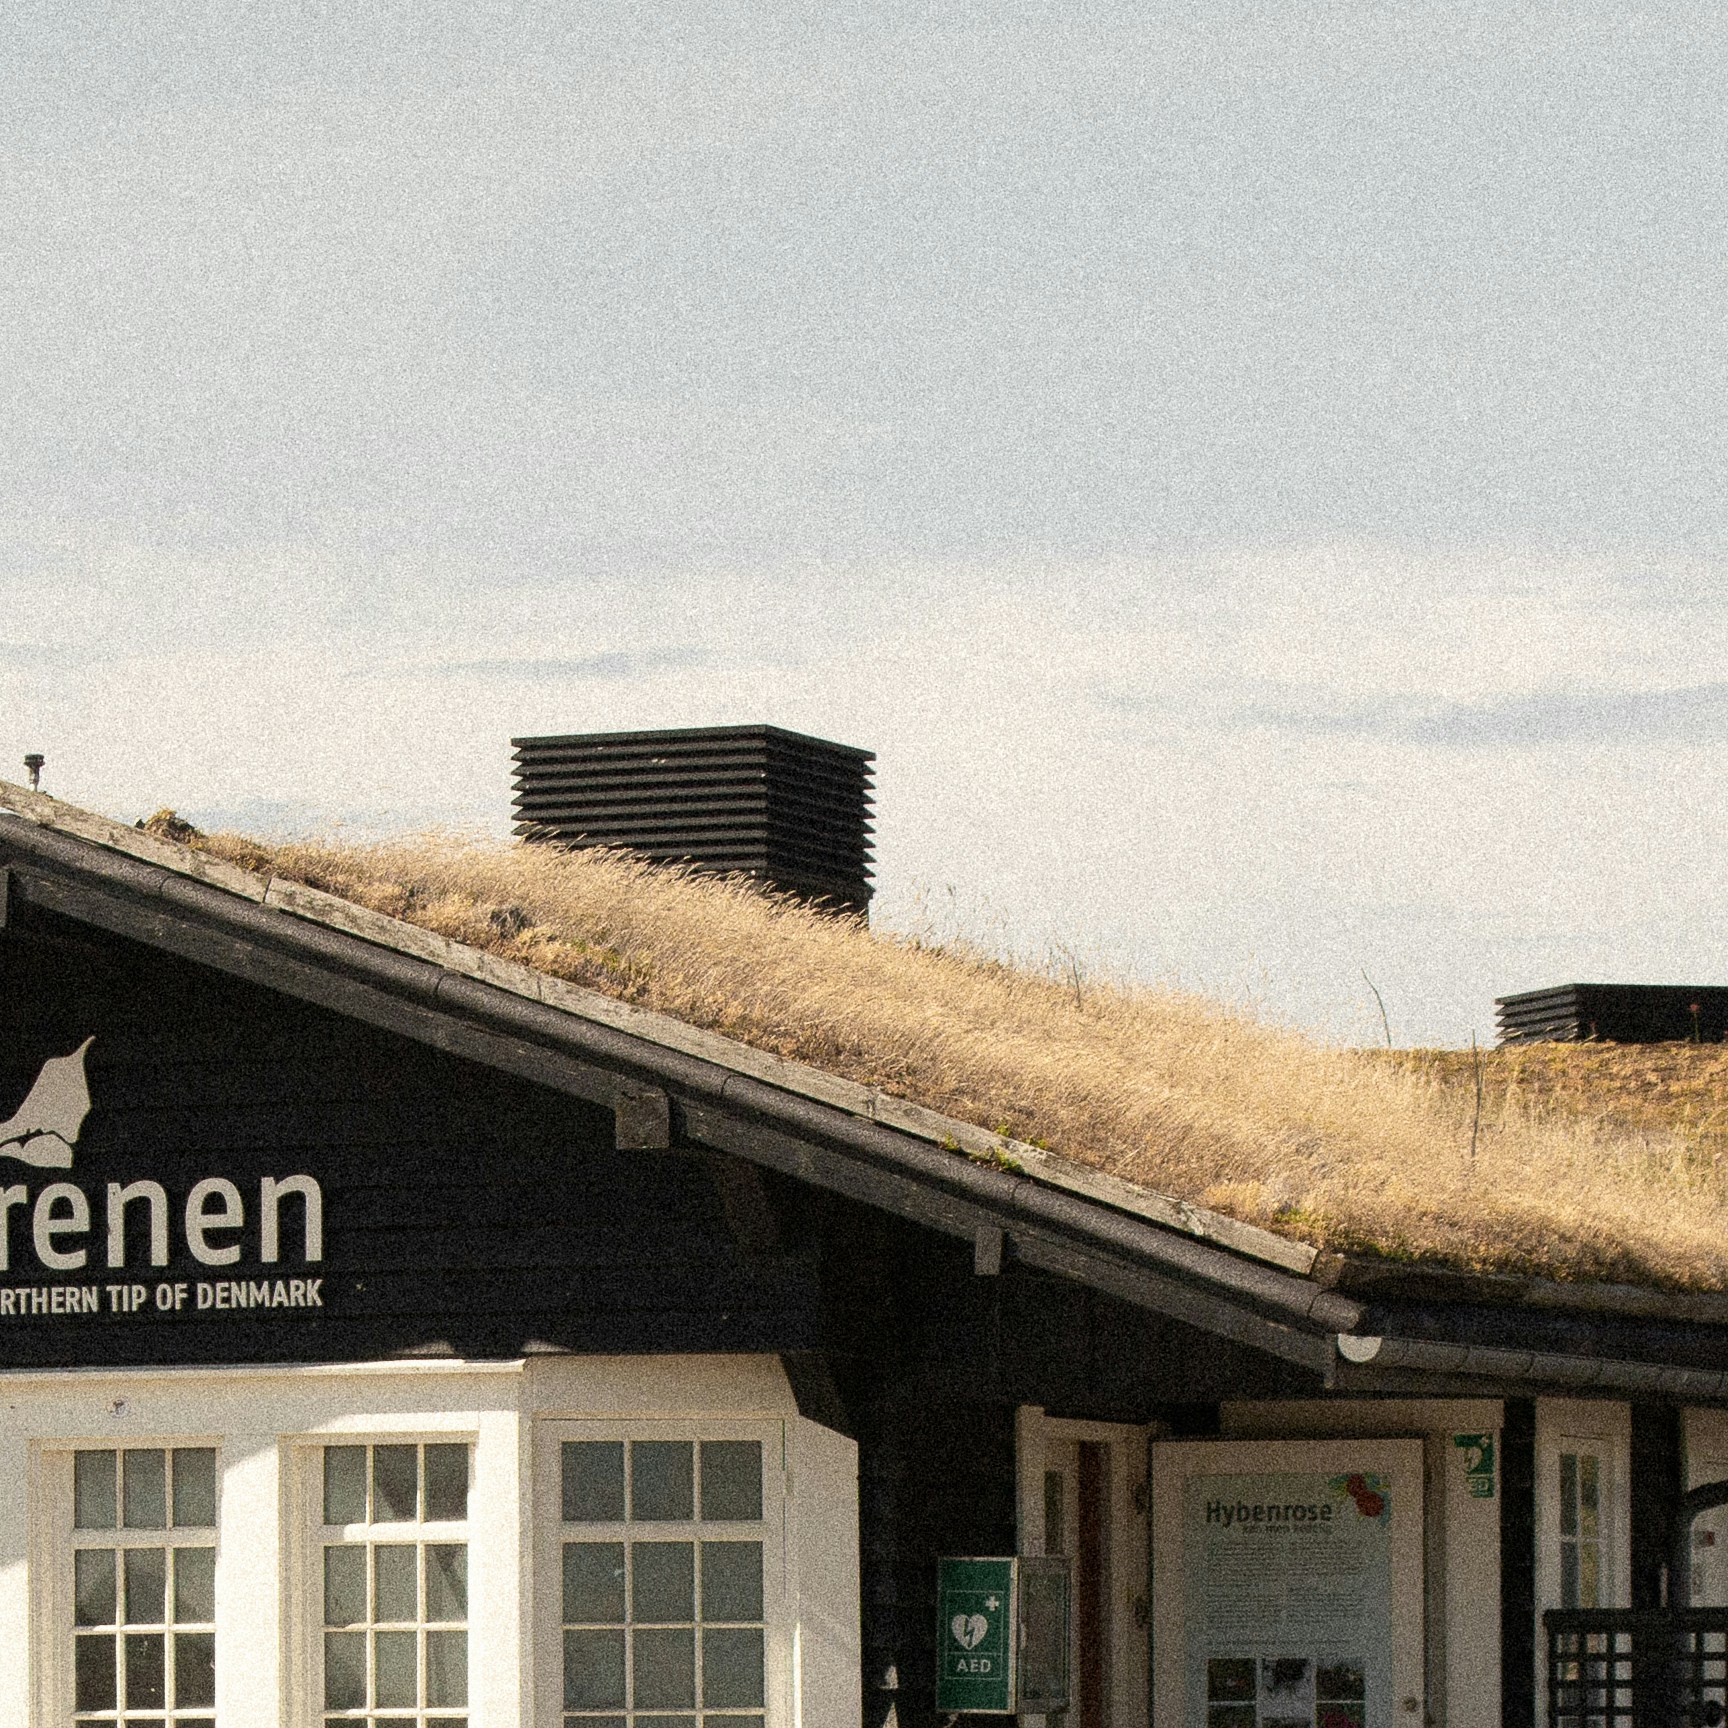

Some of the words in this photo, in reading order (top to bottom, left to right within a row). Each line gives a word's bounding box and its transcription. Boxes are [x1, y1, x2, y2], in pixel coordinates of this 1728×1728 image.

[106, 1284, 146, 1312] TIP
[155, 1282, 189, 1312] OF
[196, 1279, 323, 1310] DENMARK
[1206, 1500, 1332, 1528] Hybenrose
[957, 1659, 991, 1673] AED
